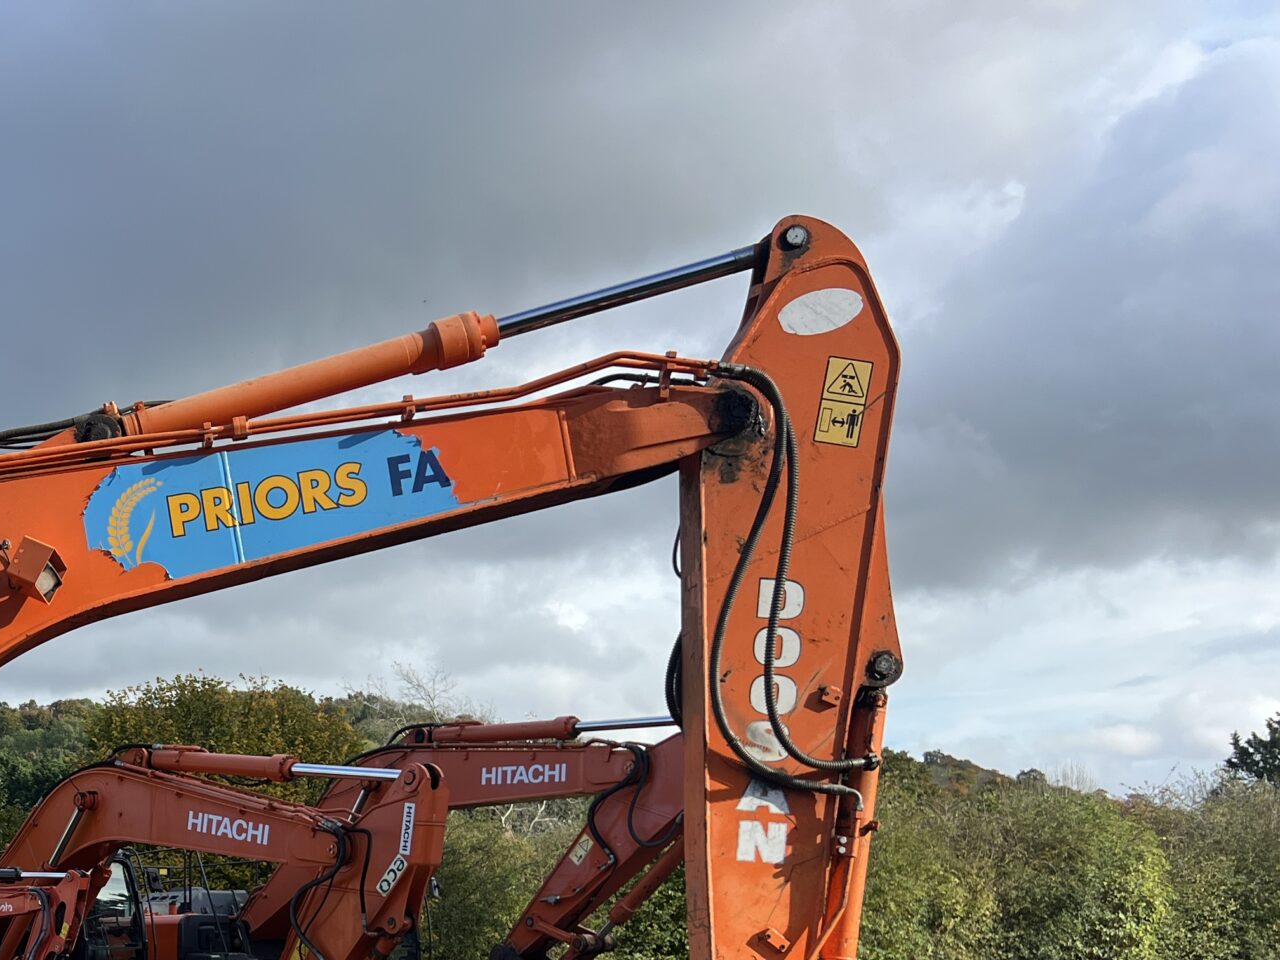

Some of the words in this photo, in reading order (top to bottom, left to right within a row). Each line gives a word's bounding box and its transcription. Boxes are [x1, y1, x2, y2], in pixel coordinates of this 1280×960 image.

[166, 462, 368, 538] PRIORS
[387, 450, 452, 497] FA
[735, 577, 806, 865] DOOSAN
[481, 763, 567, 785] HITACHI
[187, 810, 270, 846] HITACHI
[401, 805, 413, 852] HITACHI
